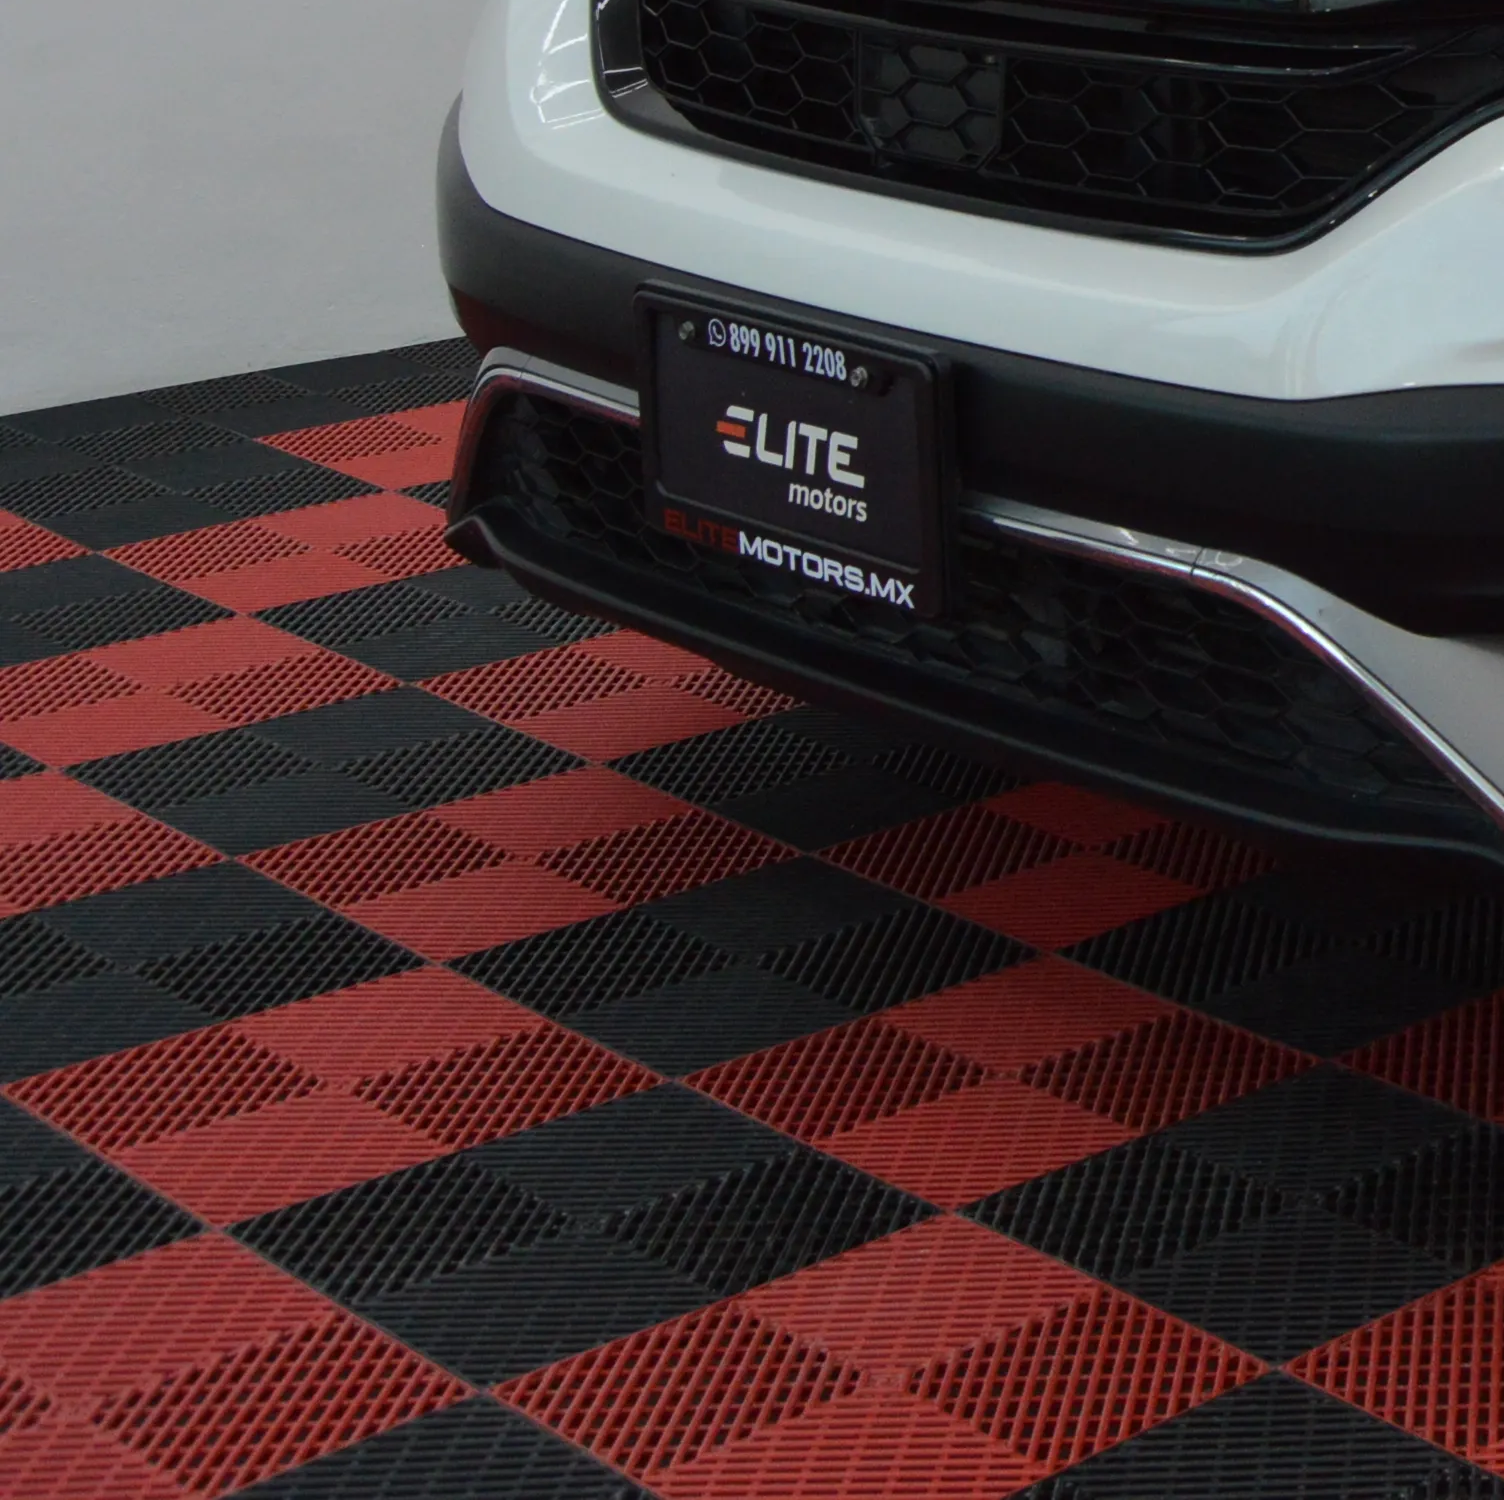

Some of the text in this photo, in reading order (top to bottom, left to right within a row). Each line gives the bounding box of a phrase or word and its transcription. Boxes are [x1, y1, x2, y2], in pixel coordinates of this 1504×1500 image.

[728, 322, 847, 381] 899 911 2208
[716, 404, 866, 489] ELITE
[788, 482, 868, 522] motors
